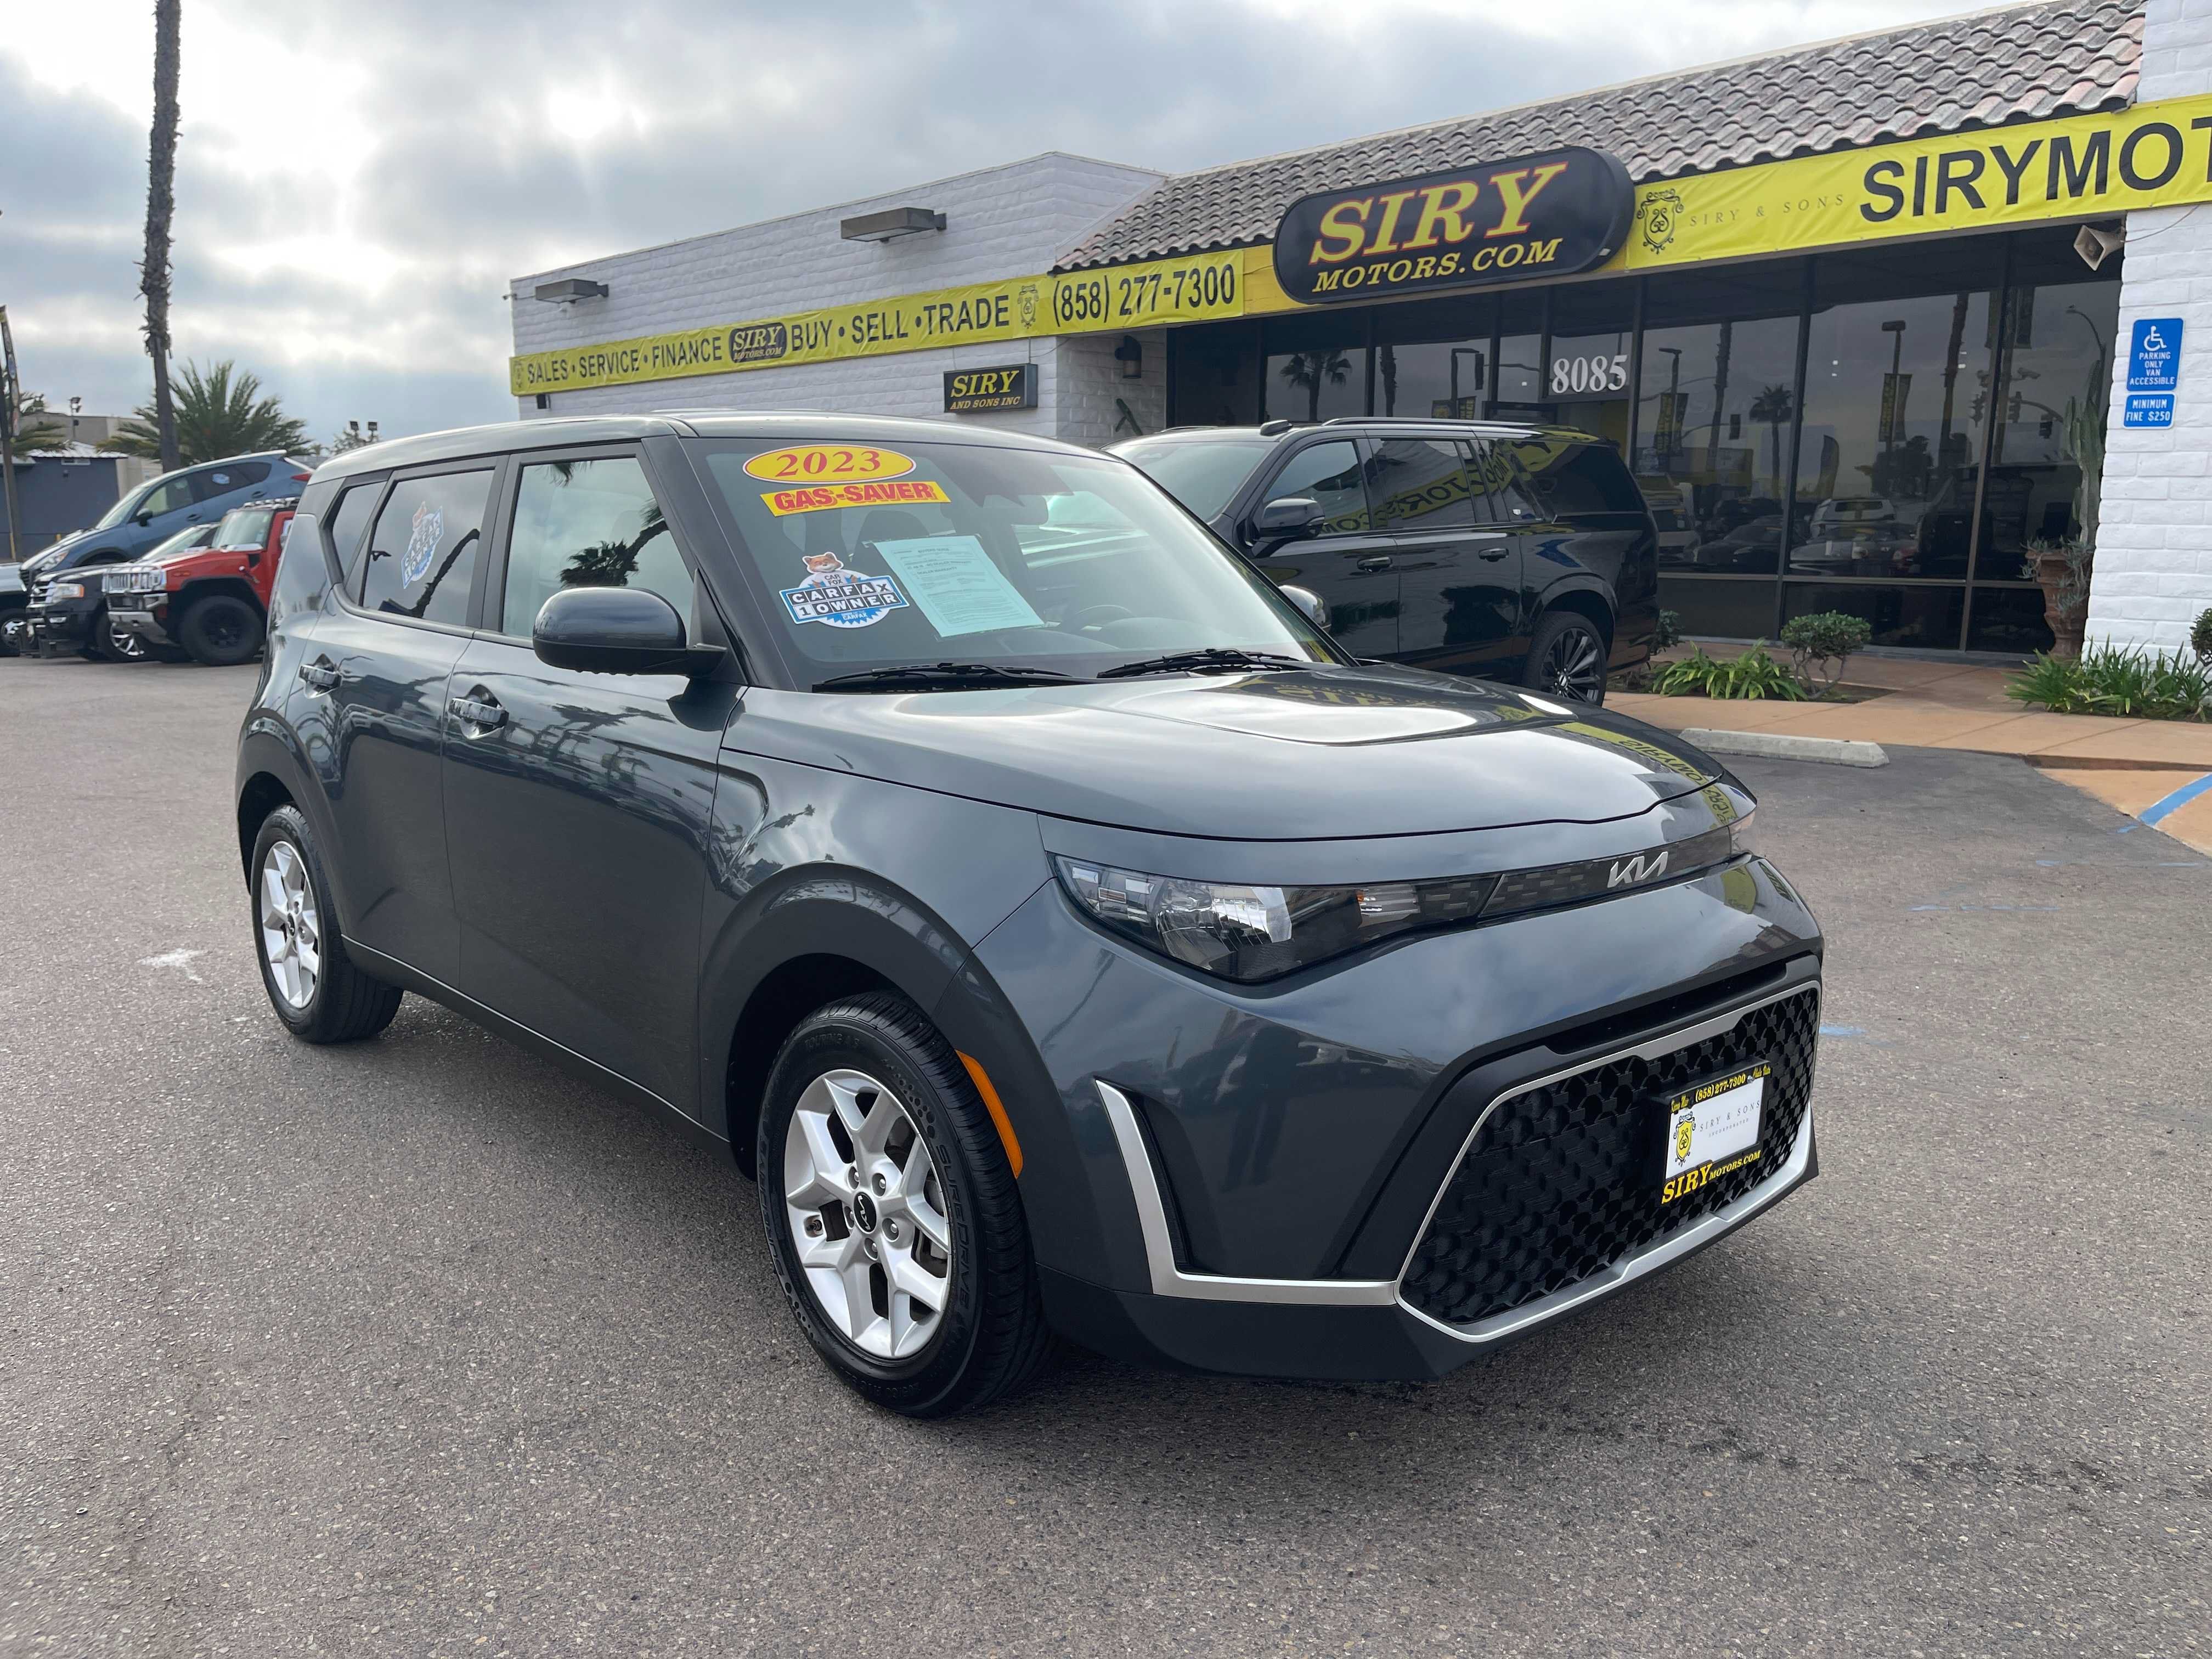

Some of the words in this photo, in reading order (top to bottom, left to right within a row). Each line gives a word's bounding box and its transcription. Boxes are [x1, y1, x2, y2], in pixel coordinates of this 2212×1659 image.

[1308, 161, 1569, 265] SIRY
[1689, 210, 1739, 227] SIRY
[1756, 205, 1765, 217] &
[1783, 193, 1845, 213] SONS
[1312, 237, 1564, 293] MOTORS.COM
[1053, 275, 1109, 327] (858)
[1119, 263, 1235, 317] 277-7300
[792, 319, 833, 351] BUY
[851, 309, 909, 344] SELL
[923, 294, 1010, 335] TRADE
[732, 325, 783, 351] SIRY
[528, 362, 569, 383] SALES
[579, 349, 640, 377] SERVICE
[652, 336, 723, 369] FINANCE
[2138, 352, 2171, 360] PARKING
[950, 370, 1020, 398] SIRY
[1551, 354, 1628, 393] 8085
[2130, 376, 2175, 385] ACCESSIBLE
[950, 400, 971, 410] AND
[972, 398, 999, 408] SONS
[1001, 396, 1020, 406] INC
[2126, 412, 2143, 421] FINE
[2148, 411, 2170, 421] $250
[2132, 399, 2167, 409] MINIMUM
[775, 450, 881, 477] 2023
[774, 482, 937, 511] GAS-SAVER
[792, 583, 890, 603] CARFAX
[799, 606, 811, 616] 1
[816, 594, 898, 614] OWNER
[1607, 851, 1668, 888] KIA
[1695, 1084, 1714, 1102] (858)
[1714, 1073, 1746, 1094] 277-7300
[1700, 1116, 1720, 1132] SIRY
[1726, 1112, 1731, 1120] &
[1737, 1100, 1760, 1116] SONS
